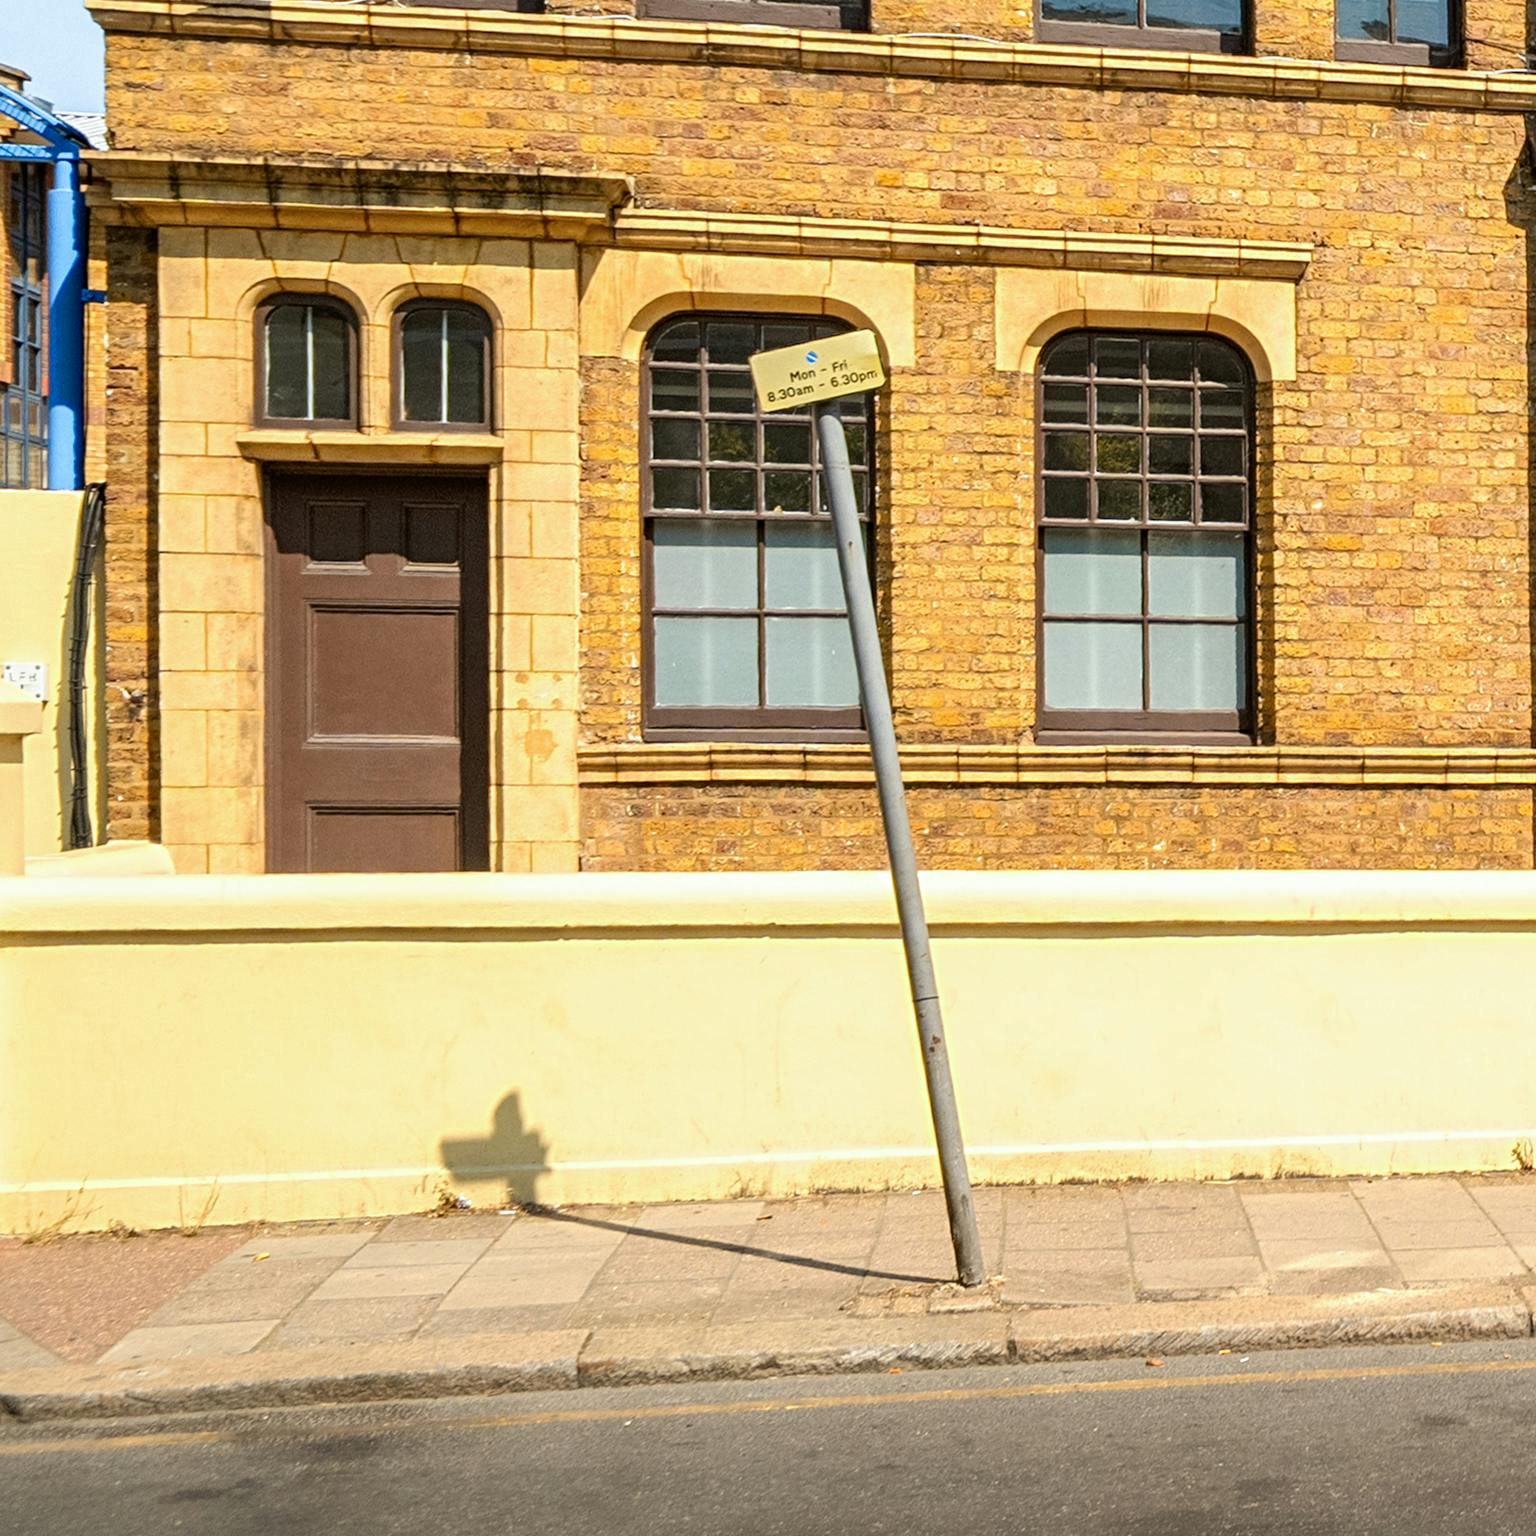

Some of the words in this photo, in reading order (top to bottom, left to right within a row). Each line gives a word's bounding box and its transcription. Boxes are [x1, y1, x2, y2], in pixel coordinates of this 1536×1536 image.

[790, 368, 816, 383] Mon
[832, 360, 849, 373] Fri
[767, 383, 814, 403] 8.30am
[830, 369, 878, 388] 6.30pm
